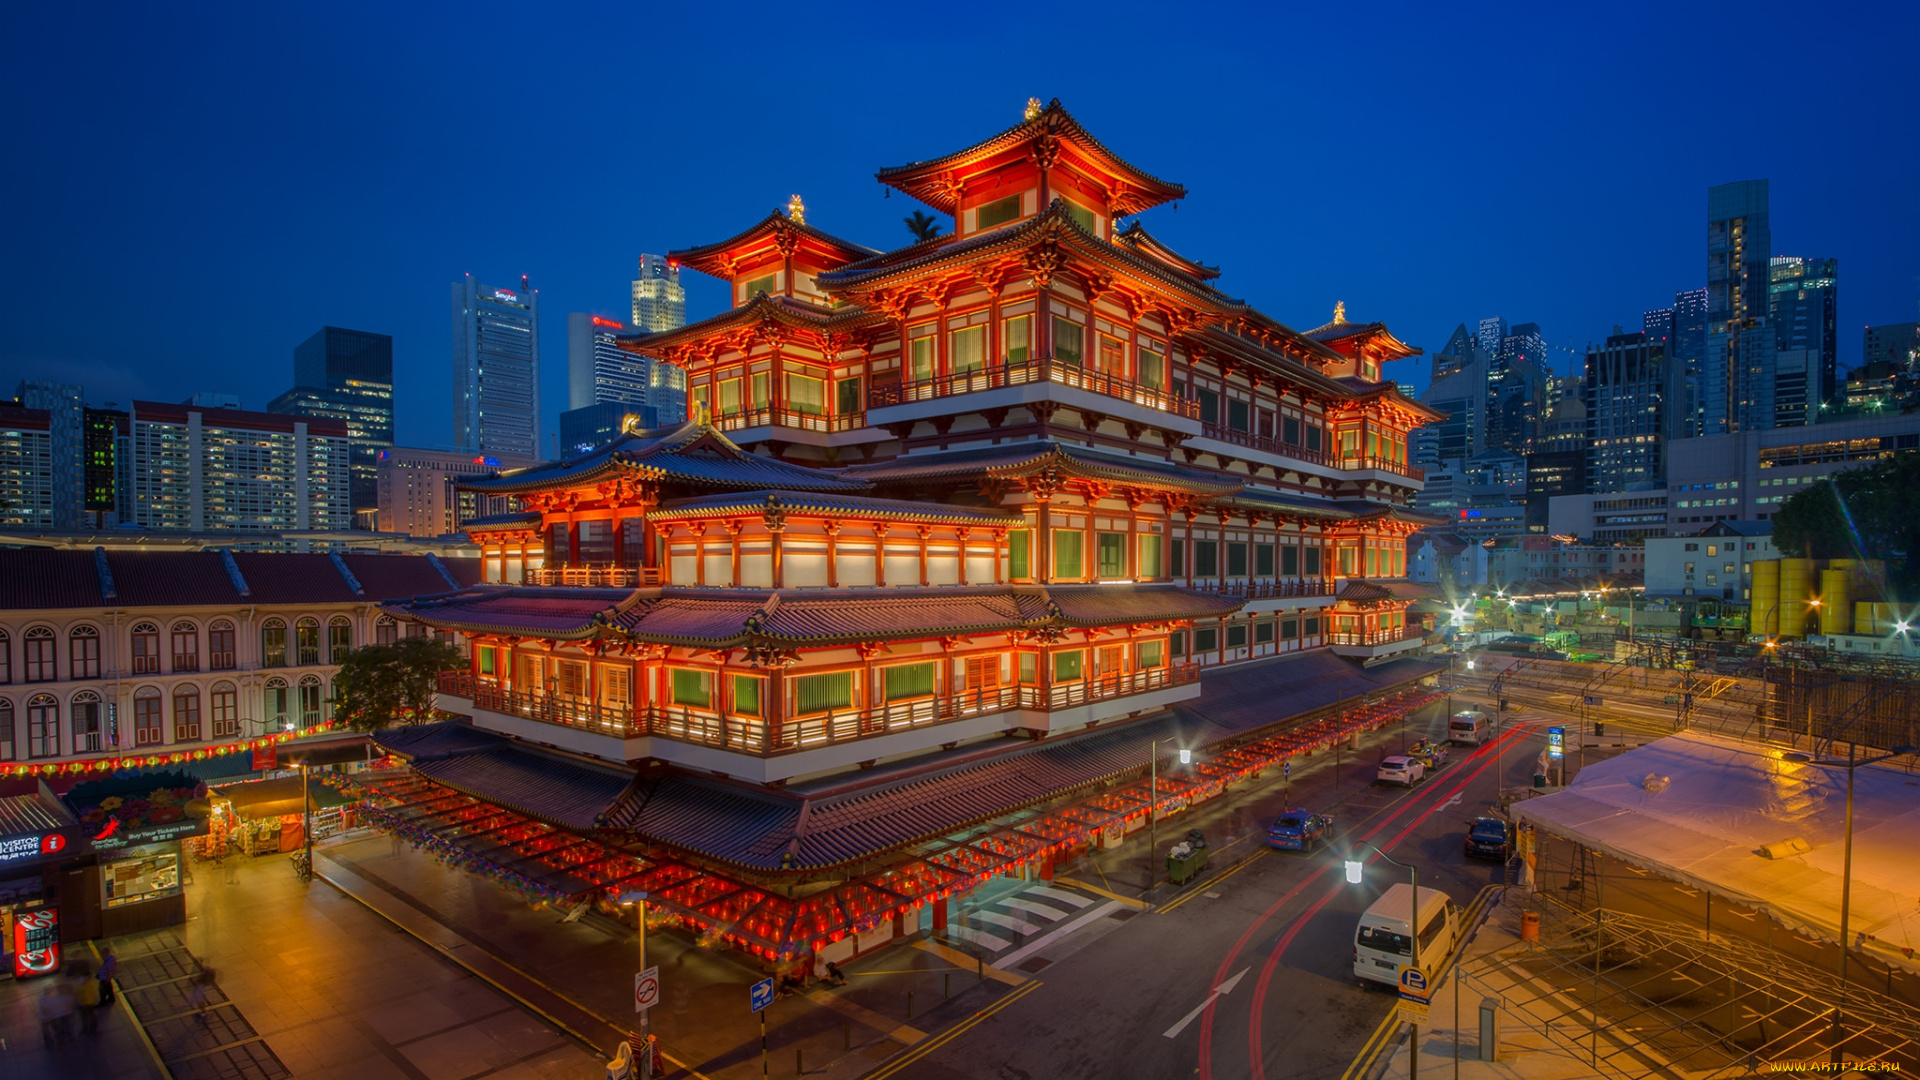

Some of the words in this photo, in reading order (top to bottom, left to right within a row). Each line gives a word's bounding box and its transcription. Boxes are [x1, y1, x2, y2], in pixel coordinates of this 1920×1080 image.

[495, 291, 517, 302] Singtel
[157, 828, 179, 836] Tickets
[2, 836, 39, 847] VISITOR
[2, 843, 39, 854] CENTRE
